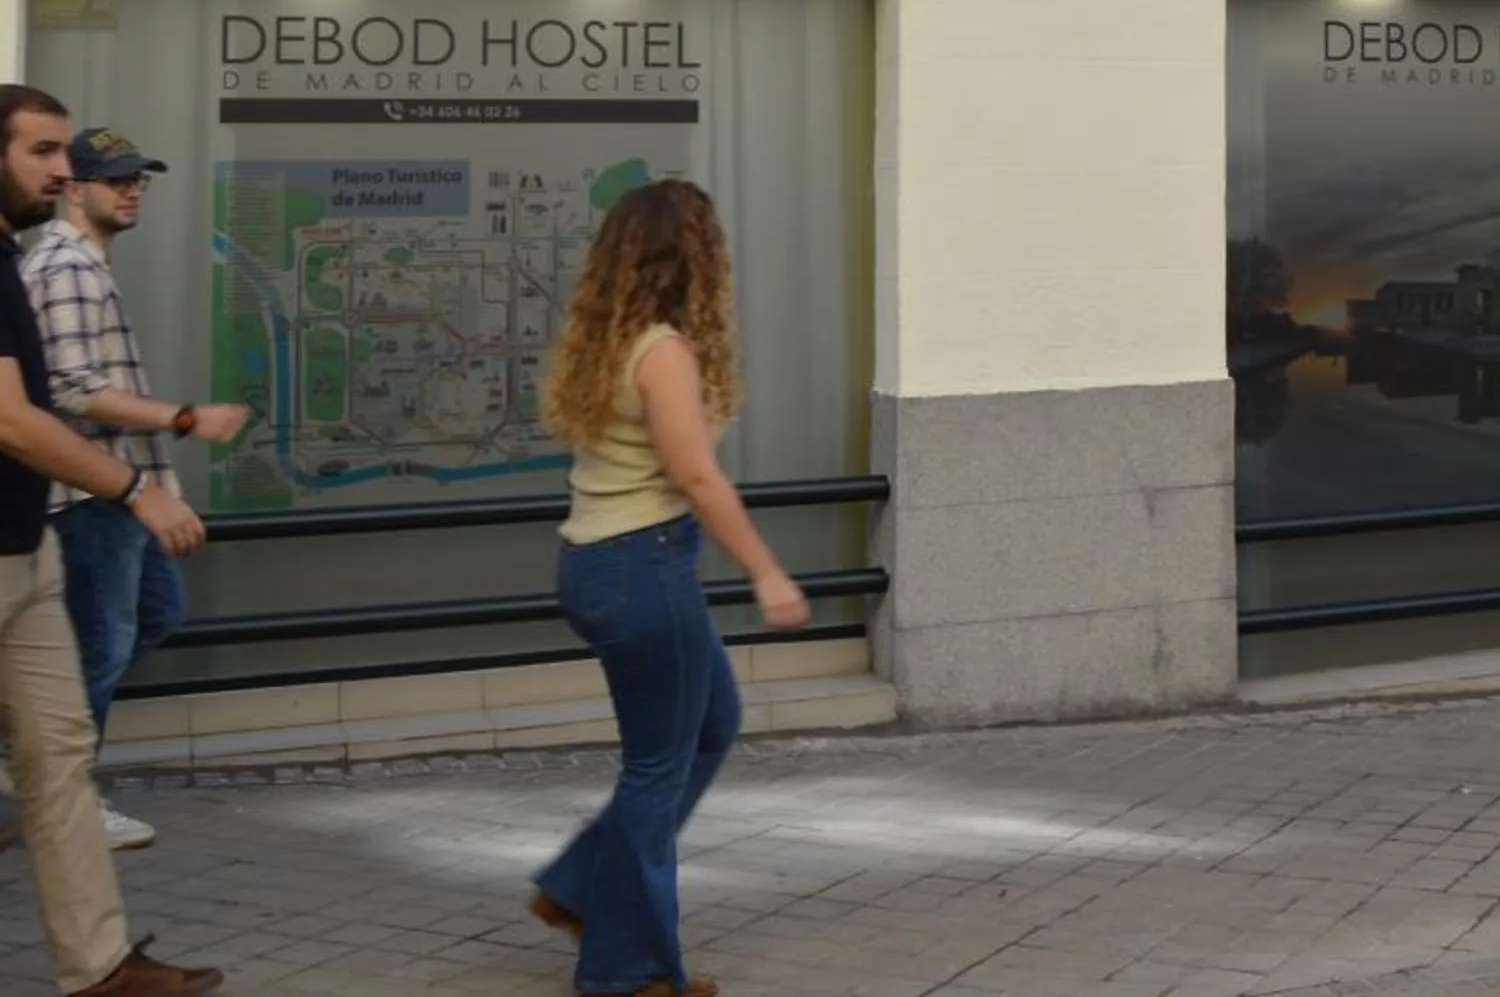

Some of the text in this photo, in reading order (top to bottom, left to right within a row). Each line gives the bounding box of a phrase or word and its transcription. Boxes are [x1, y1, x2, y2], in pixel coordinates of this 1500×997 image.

[222, 15, 702, 68] DEBOD HOSTEL
[1324, 21, 1483, 64] DEBOD
[223, 70, 701, 93] DE MADRID AL CIELO
[1324, 66, 1357, 84] DE
[1381, 68, 1496, 86] MADRID
[332, 168, 384, 184] Plano
[331, 189, 424, 207] de Madrid
